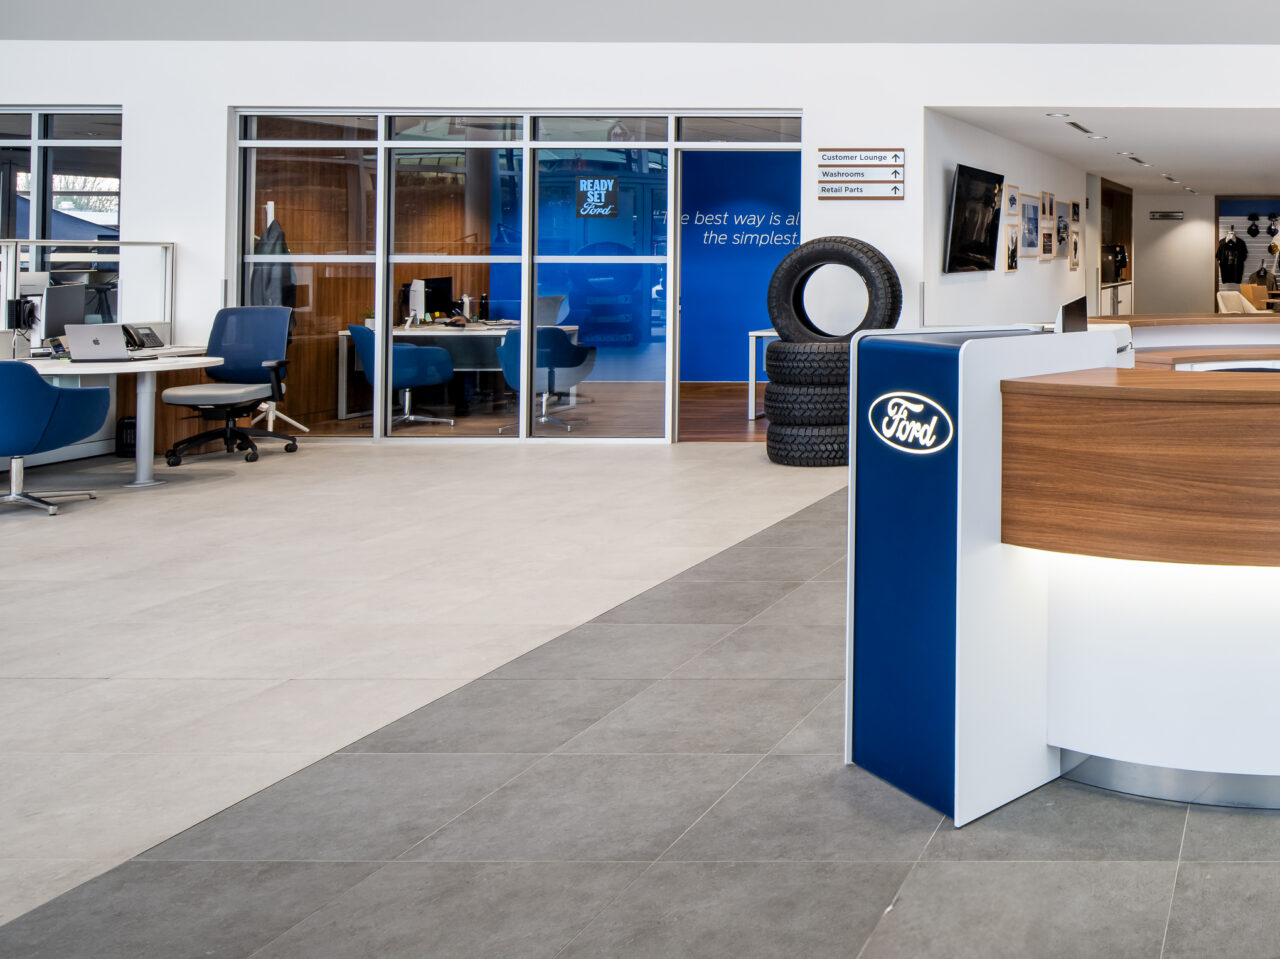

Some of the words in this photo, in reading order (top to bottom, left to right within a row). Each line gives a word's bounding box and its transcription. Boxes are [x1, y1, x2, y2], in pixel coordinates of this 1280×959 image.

[860, 154, 887, 162] Lounge
[579, 179, 614, 191] READY
[587, 191, 606, 202] SET
[580, 202, 611, 215] Ford
[695, 211, 728, 225] best
[733, 214, 765, 227] way
[769, 212, 781, 225] is
[703, 231, 728, 245] the
[732, 231, 801, 248] simplest.
[882, 397, 938, 447] Ford
